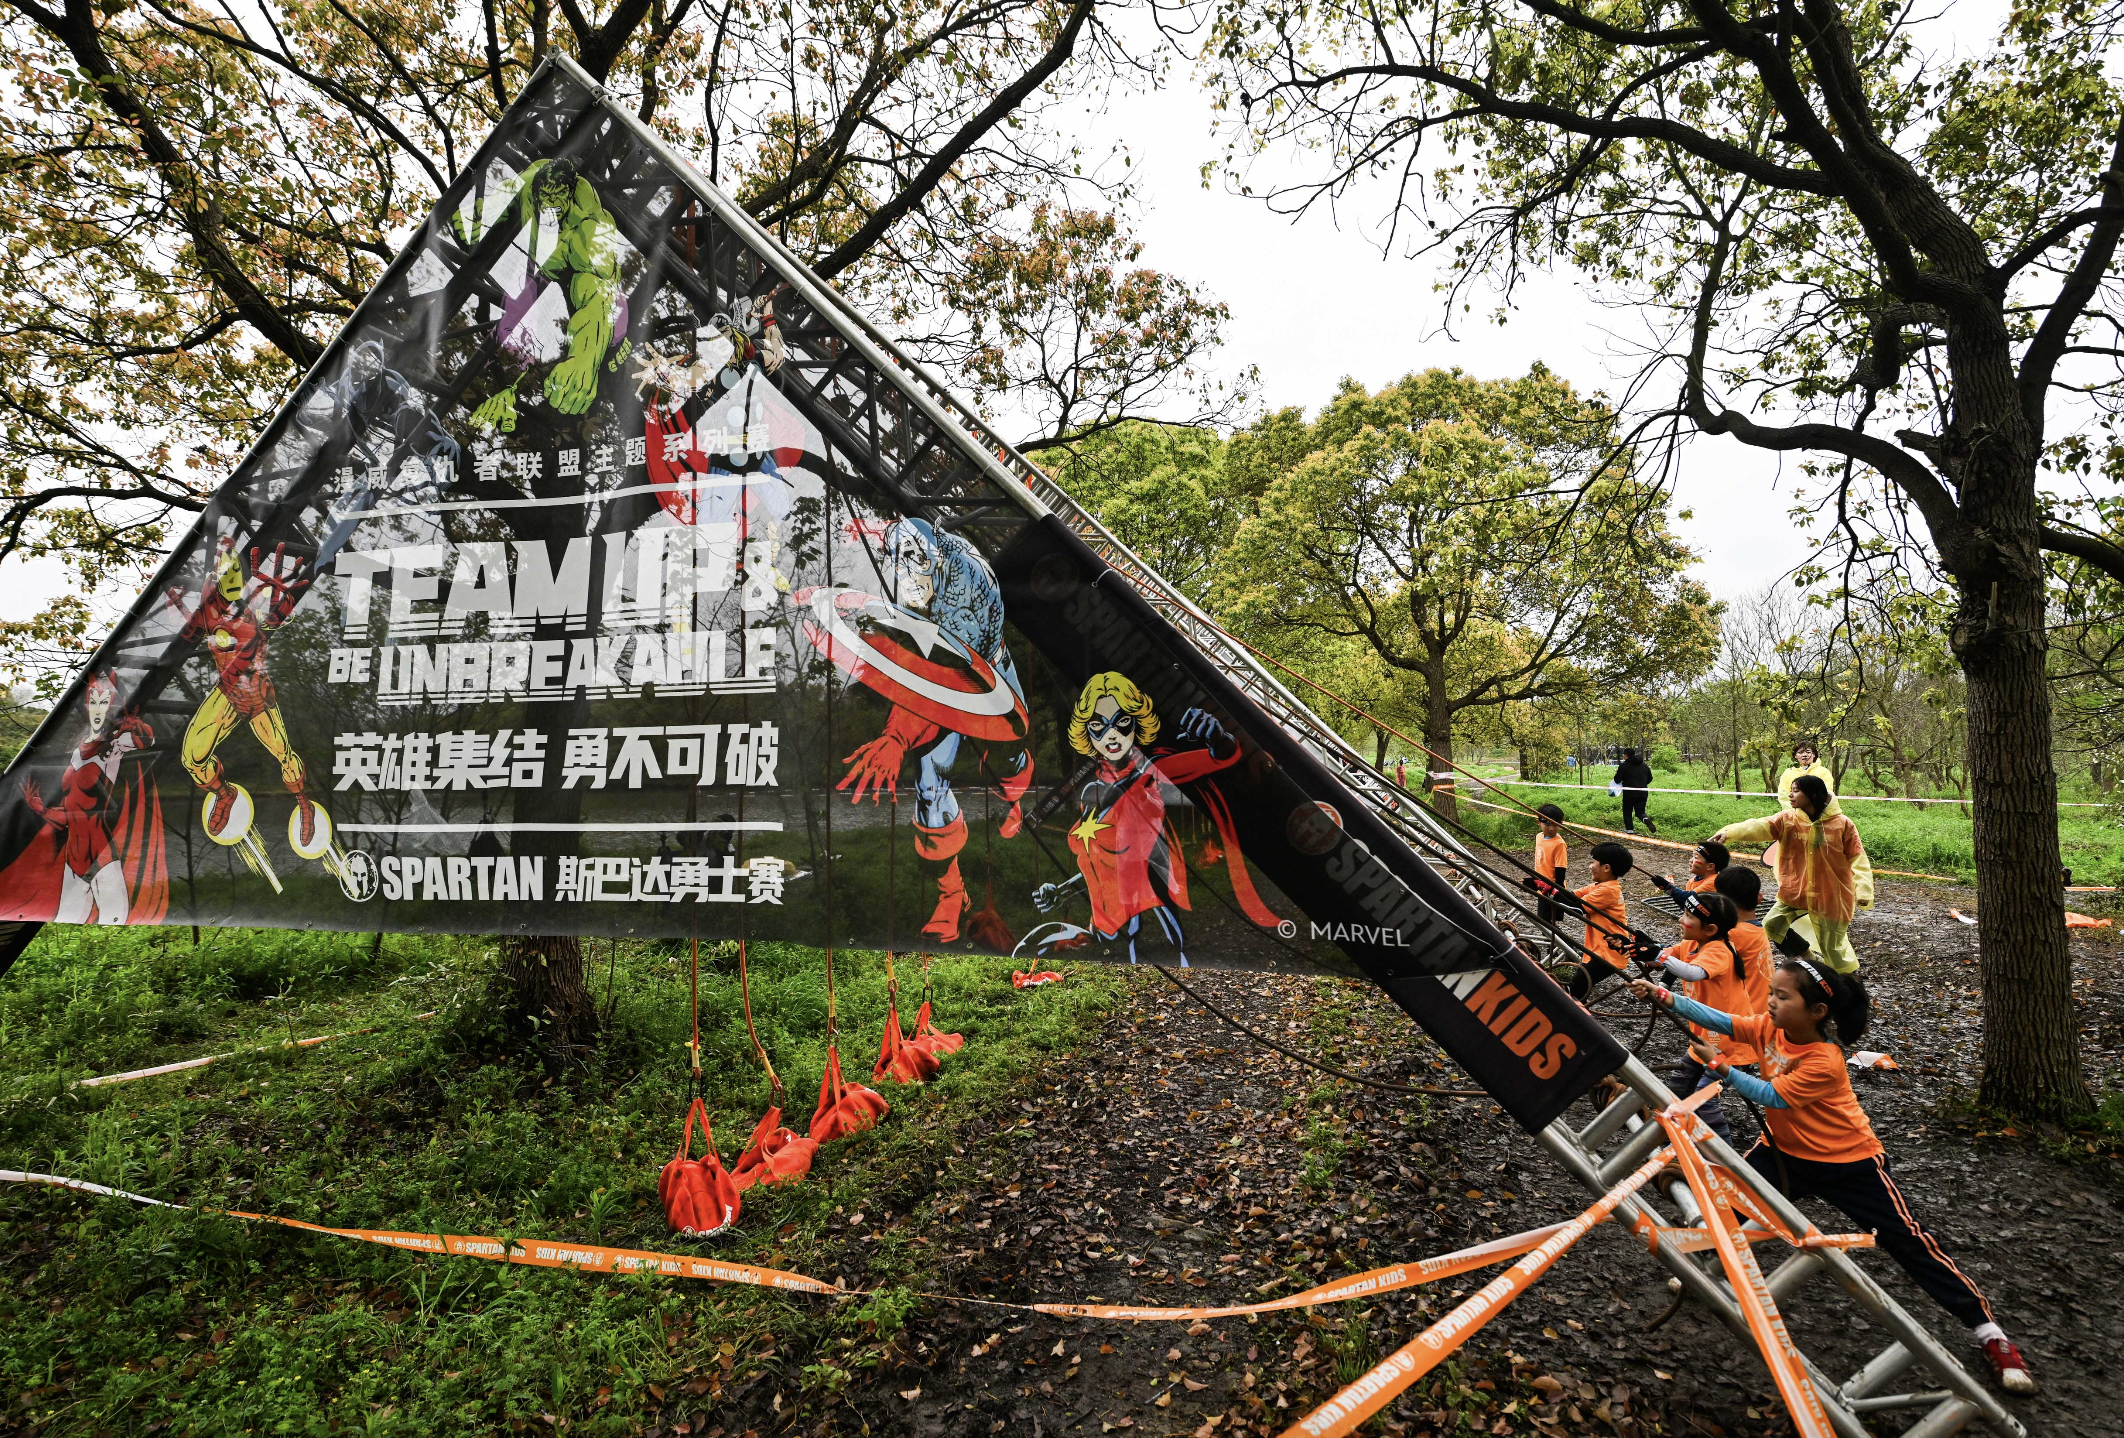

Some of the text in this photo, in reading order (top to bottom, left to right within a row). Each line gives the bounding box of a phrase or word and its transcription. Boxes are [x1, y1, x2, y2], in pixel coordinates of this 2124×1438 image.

[334, 535, 592, 640] TEAM
[601, 522, 738, 627] UP
[327, 647, 373, 684] BE
[332, 720, 779, 791] 英雄集结 勇不可破
[381, 855, 543, 901] SPARTAN
[555, 855, 785, 905] 斯巴达勇士赛
[1310, 921, 1410, 947] MARVEL
[1326, 1268, 1407, 1299] SPARTAN KIDS
[1436, 1274, 1515, 1339] SPARTAN KIDS
[1738, 1249, 1779, 1318] SPARTAN
[1300, 1361, 1401, 1437] SPARTAN KIDS
